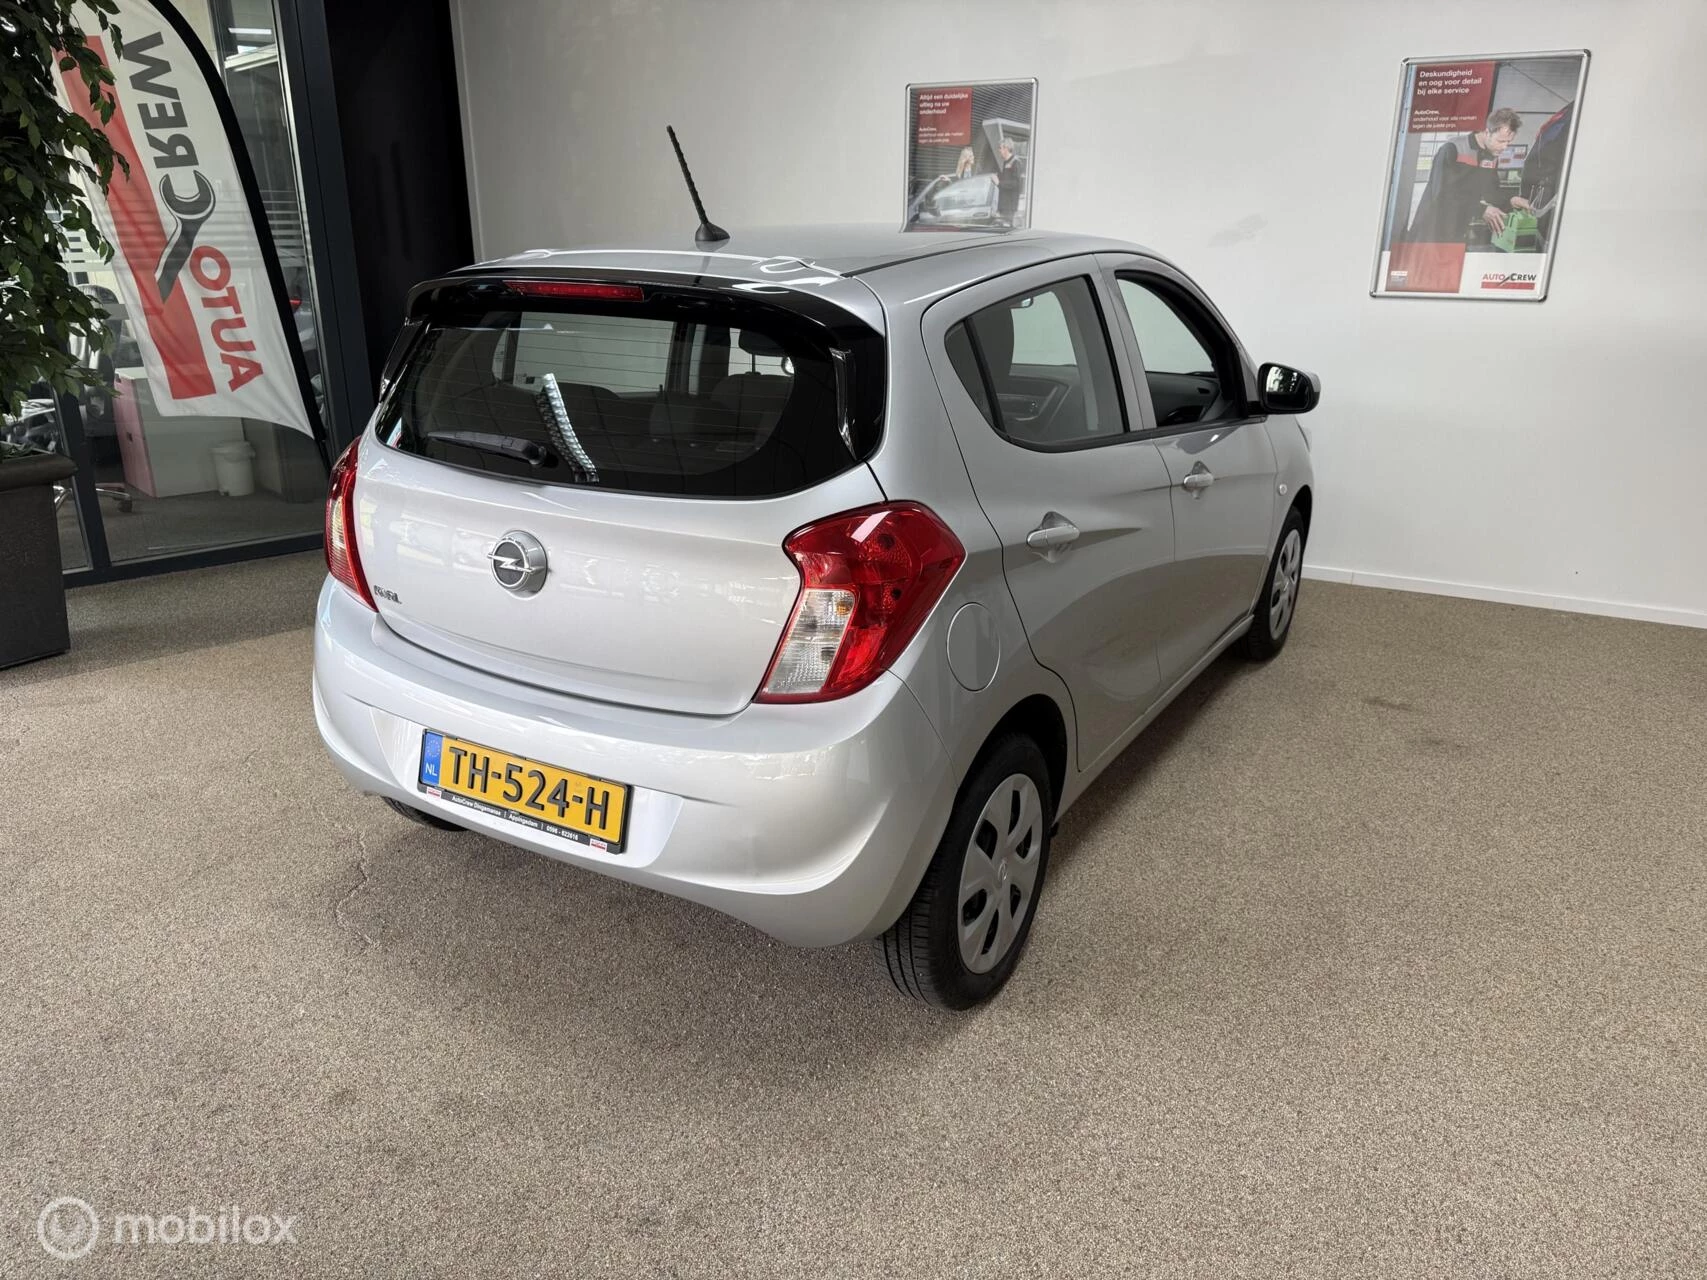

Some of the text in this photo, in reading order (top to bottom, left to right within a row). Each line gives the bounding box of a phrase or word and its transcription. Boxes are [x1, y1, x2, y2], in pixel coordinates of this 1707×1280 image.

[1420, 69, 1473, 78] Deskundigheid
[1429, 80, 1443, 88] oog
[1462, 77, 1483, 85] detail
[1417, 88, 1427, 97] bij
[1444, 87, 1470, 95] service
[1482, 272, 1538, 282] AUTO CREW
[424, 746, 610, 830] NL TH-524-H
